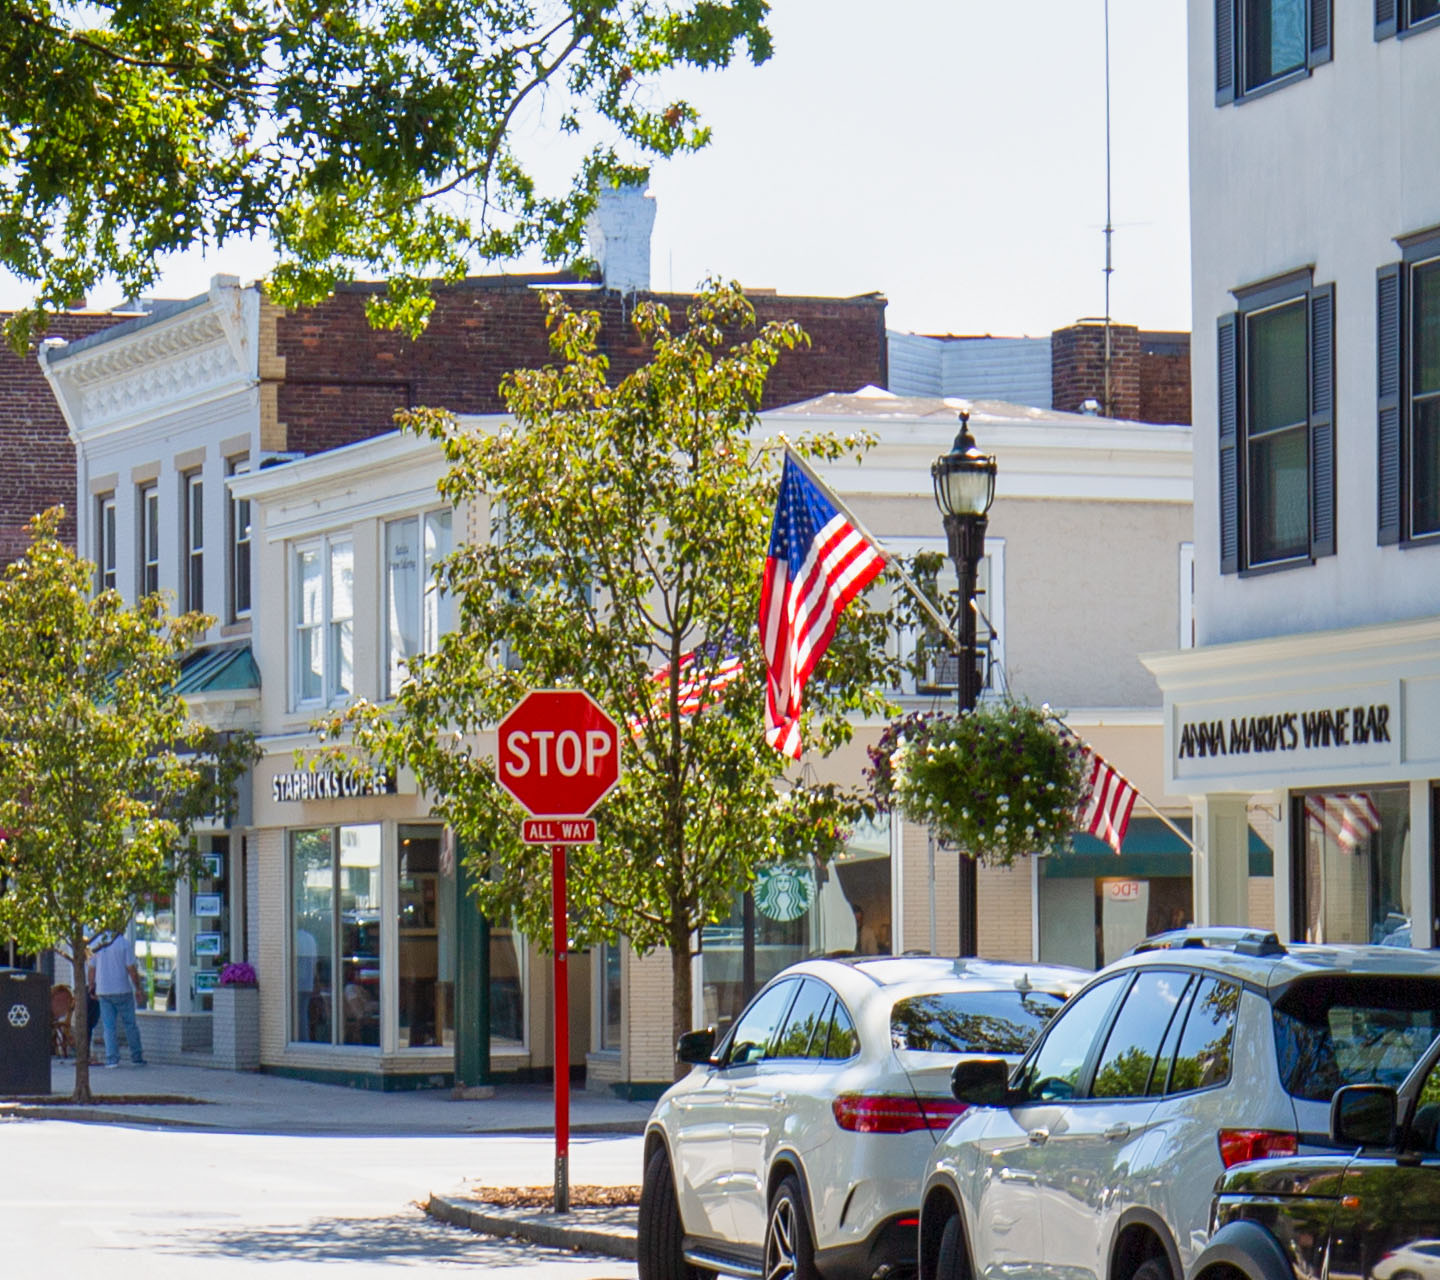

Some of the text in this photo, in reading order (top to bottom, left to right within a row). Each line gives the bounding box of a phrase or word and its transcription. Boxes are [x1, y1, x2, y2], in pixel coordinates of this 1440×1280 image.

[1178, 703, 1391, 759] ANNA MARIA'S WINE BAR
[505, 730, 612, 777] STOP
[272, 770, 340, 802] STARBUCKS
[529, 823, 590, 839] ALL WAY
